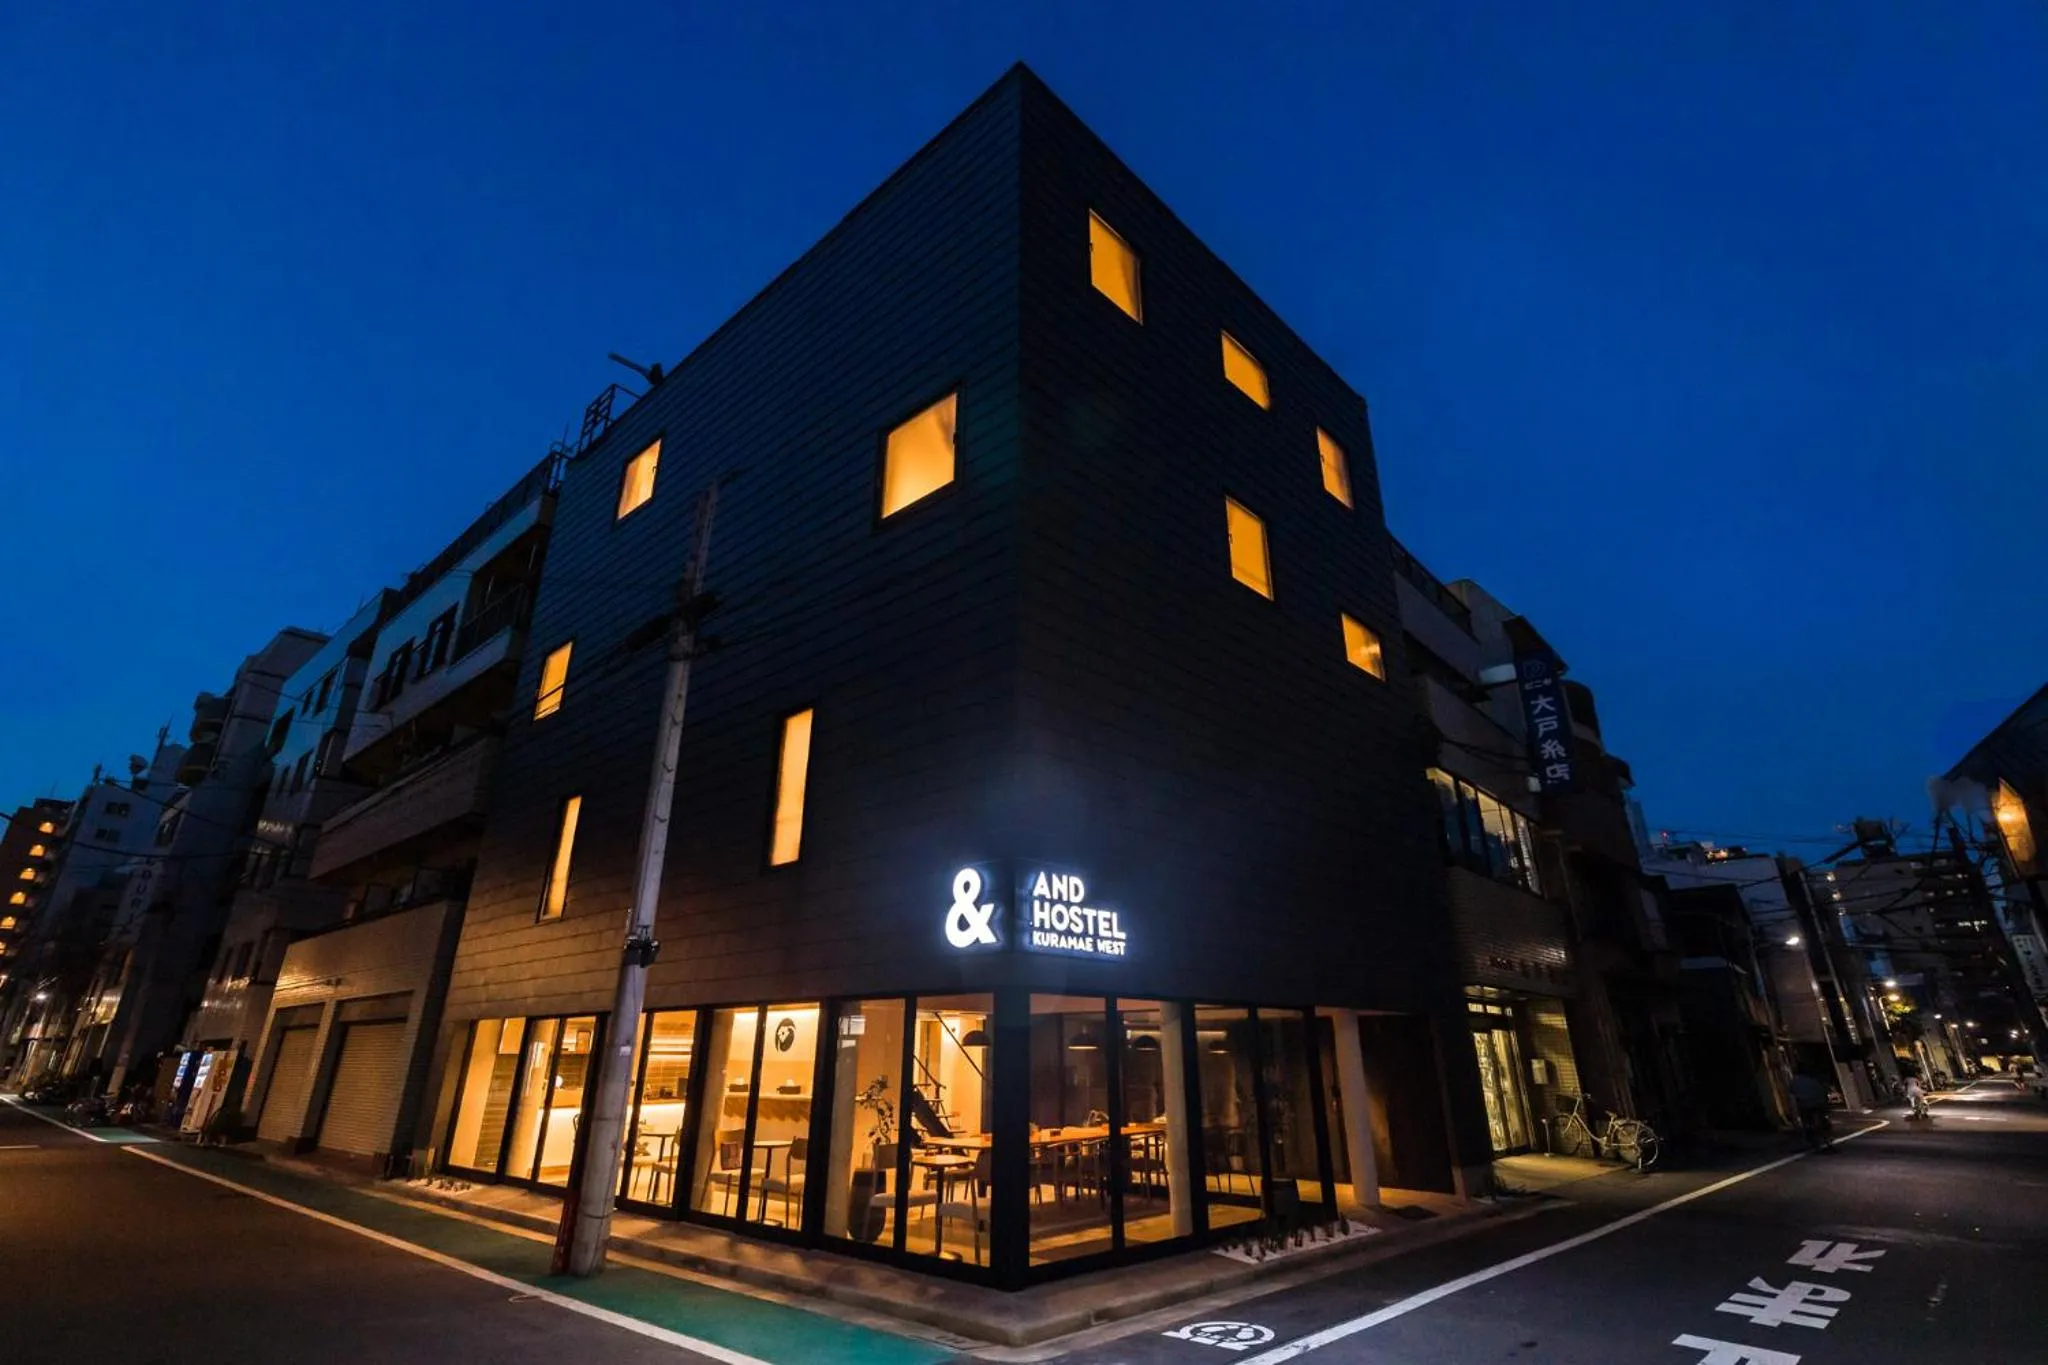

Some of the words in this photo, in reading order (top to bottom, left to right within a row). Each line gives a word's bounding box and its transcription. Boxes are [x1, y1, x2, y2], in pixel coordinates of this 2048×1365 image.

[1032, 871, 1085, 903] AND
[944, 867, 997, 948] &
[1033, 900, 1126, 939] HOSTEL
[1032, 931, 1094, 952] KURAMAE
[1096, 938, 1126, 956] WEST
